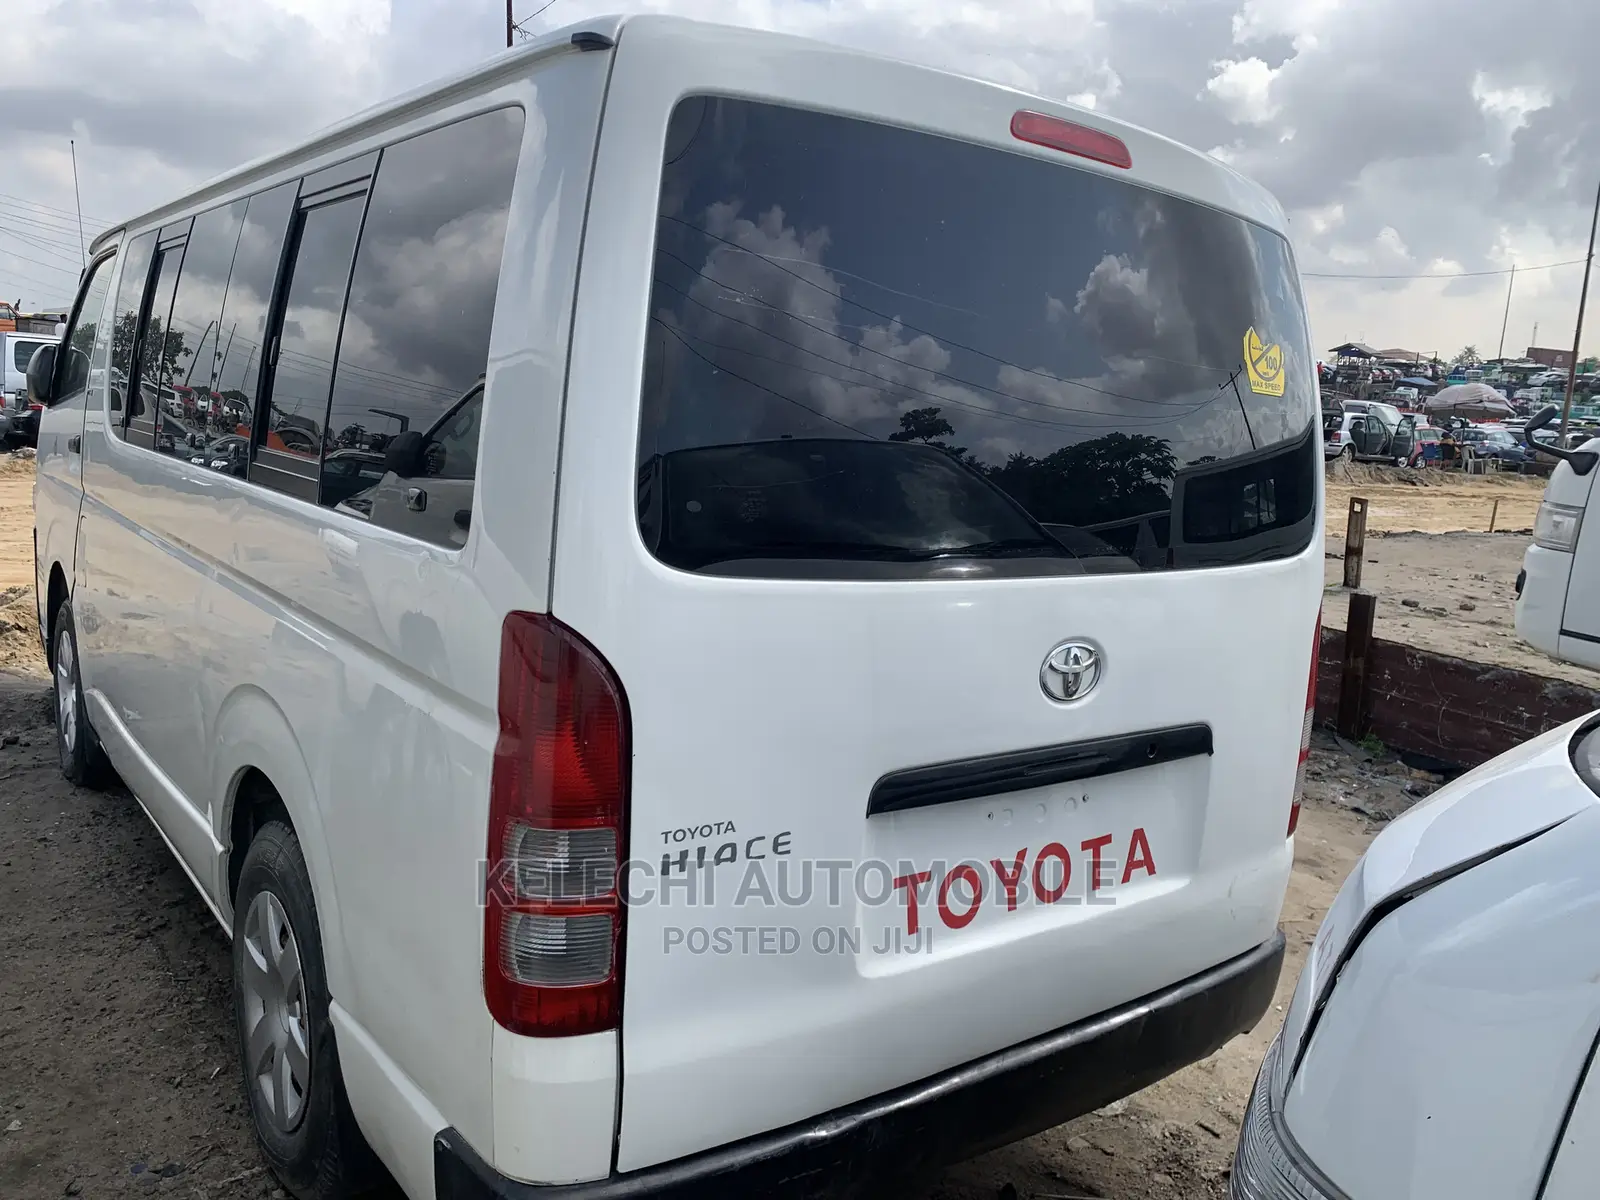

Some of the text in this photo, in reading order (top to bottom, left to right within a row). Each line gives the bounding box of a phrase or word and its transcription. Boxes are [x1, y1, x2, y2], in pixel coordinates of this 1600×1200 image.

[1265, 355, 1277, 371] 100
[1252, 380, 1281, 391] MAX SPEED
[661, 820, 736, 844] TOYOTA
[660, 831, 792, 876] HIACE
[893, 827, 1157, 936] TOYOTA
